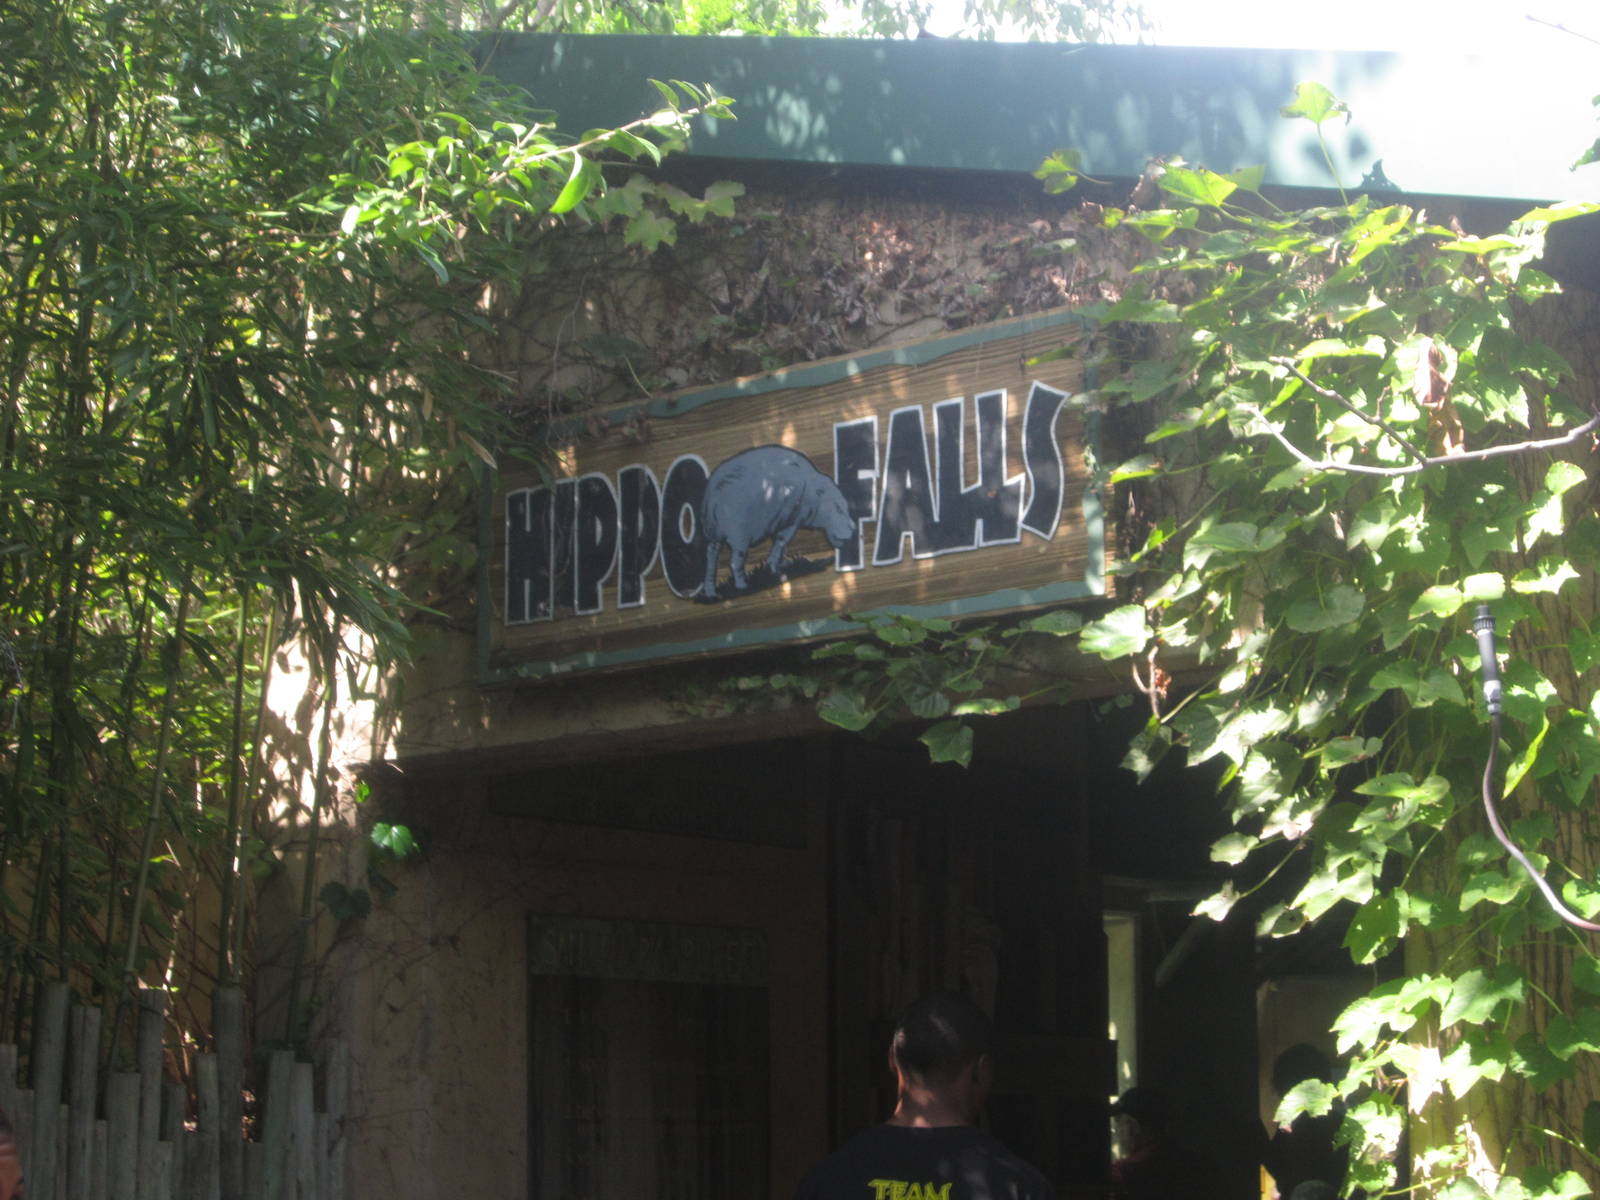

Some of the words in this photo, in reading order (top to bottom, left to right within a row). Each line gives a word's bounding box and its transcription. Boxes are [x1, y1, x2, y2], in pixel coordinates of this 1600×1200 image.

[505, 454, 709, 625] HIPPO
[833, 380, 1072, 572] FALLS
[867, 1179, 952, 1200] TEAM
